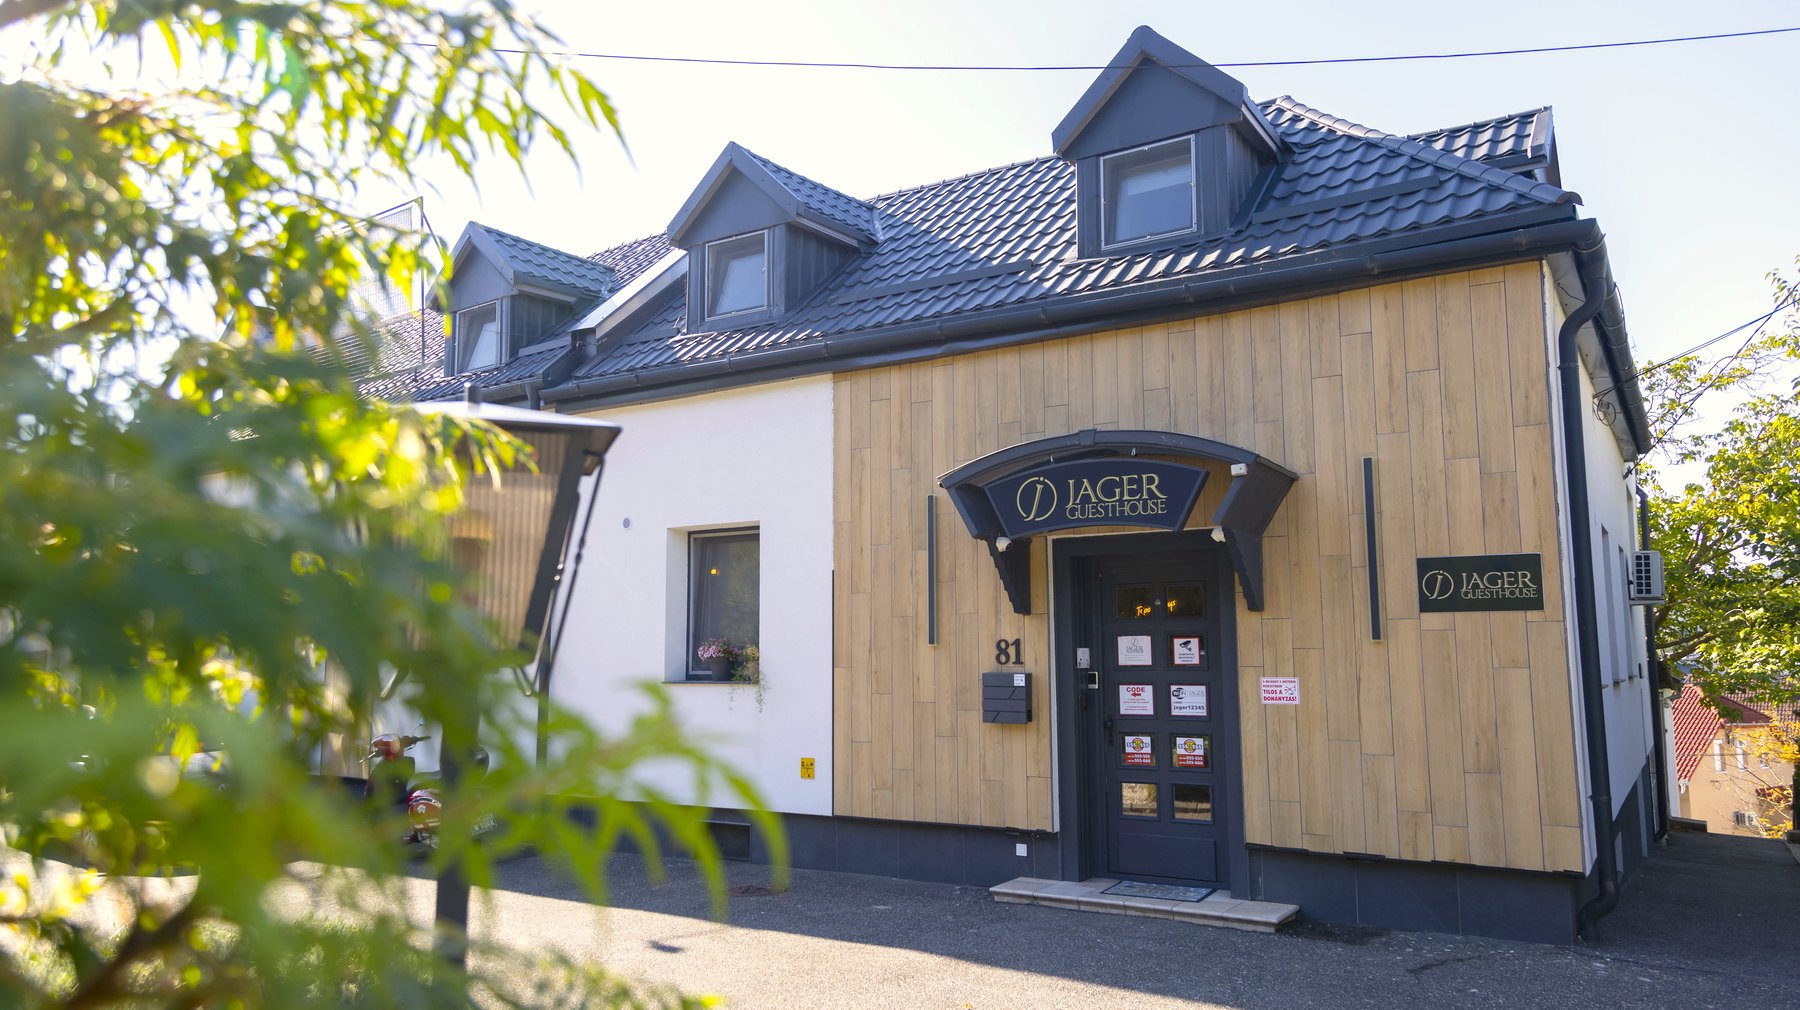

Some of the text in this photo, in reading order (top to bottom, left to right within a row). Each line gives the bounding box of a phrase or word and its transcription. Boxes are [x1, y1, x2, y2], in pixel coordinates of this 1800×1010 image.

[1066, 473, 1168, 508] JAGER
[1066, 499, 1168, 519] GUESTHOUSE
[1460, 571, 1538, 591] JAGER
[1461, 588, 1538, 599] GUESTHOUSE
[995, 638, 1024, 665] 81
